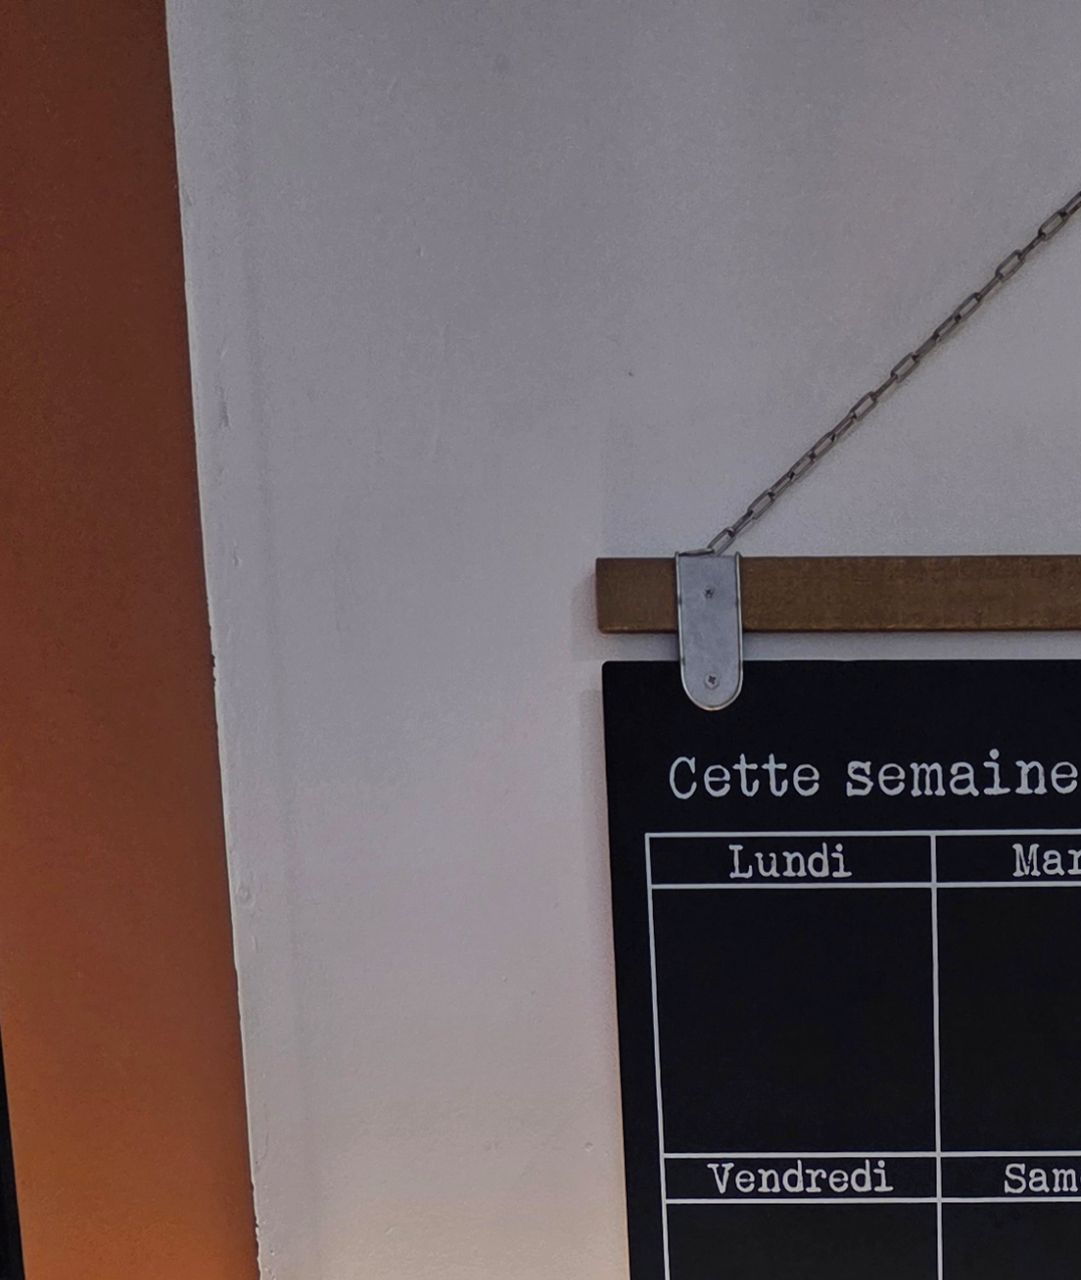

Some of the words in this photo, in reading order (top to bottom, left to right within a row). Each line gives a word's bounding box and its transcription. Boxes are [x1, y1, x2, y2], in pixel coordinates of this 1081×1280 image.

[669, 753, 821, 800] Cette
[846, 748, 1079, 797] semaine
[728, 842, 853, 879] Lundi
[706, 1159, 895, 1194] Vendredi
